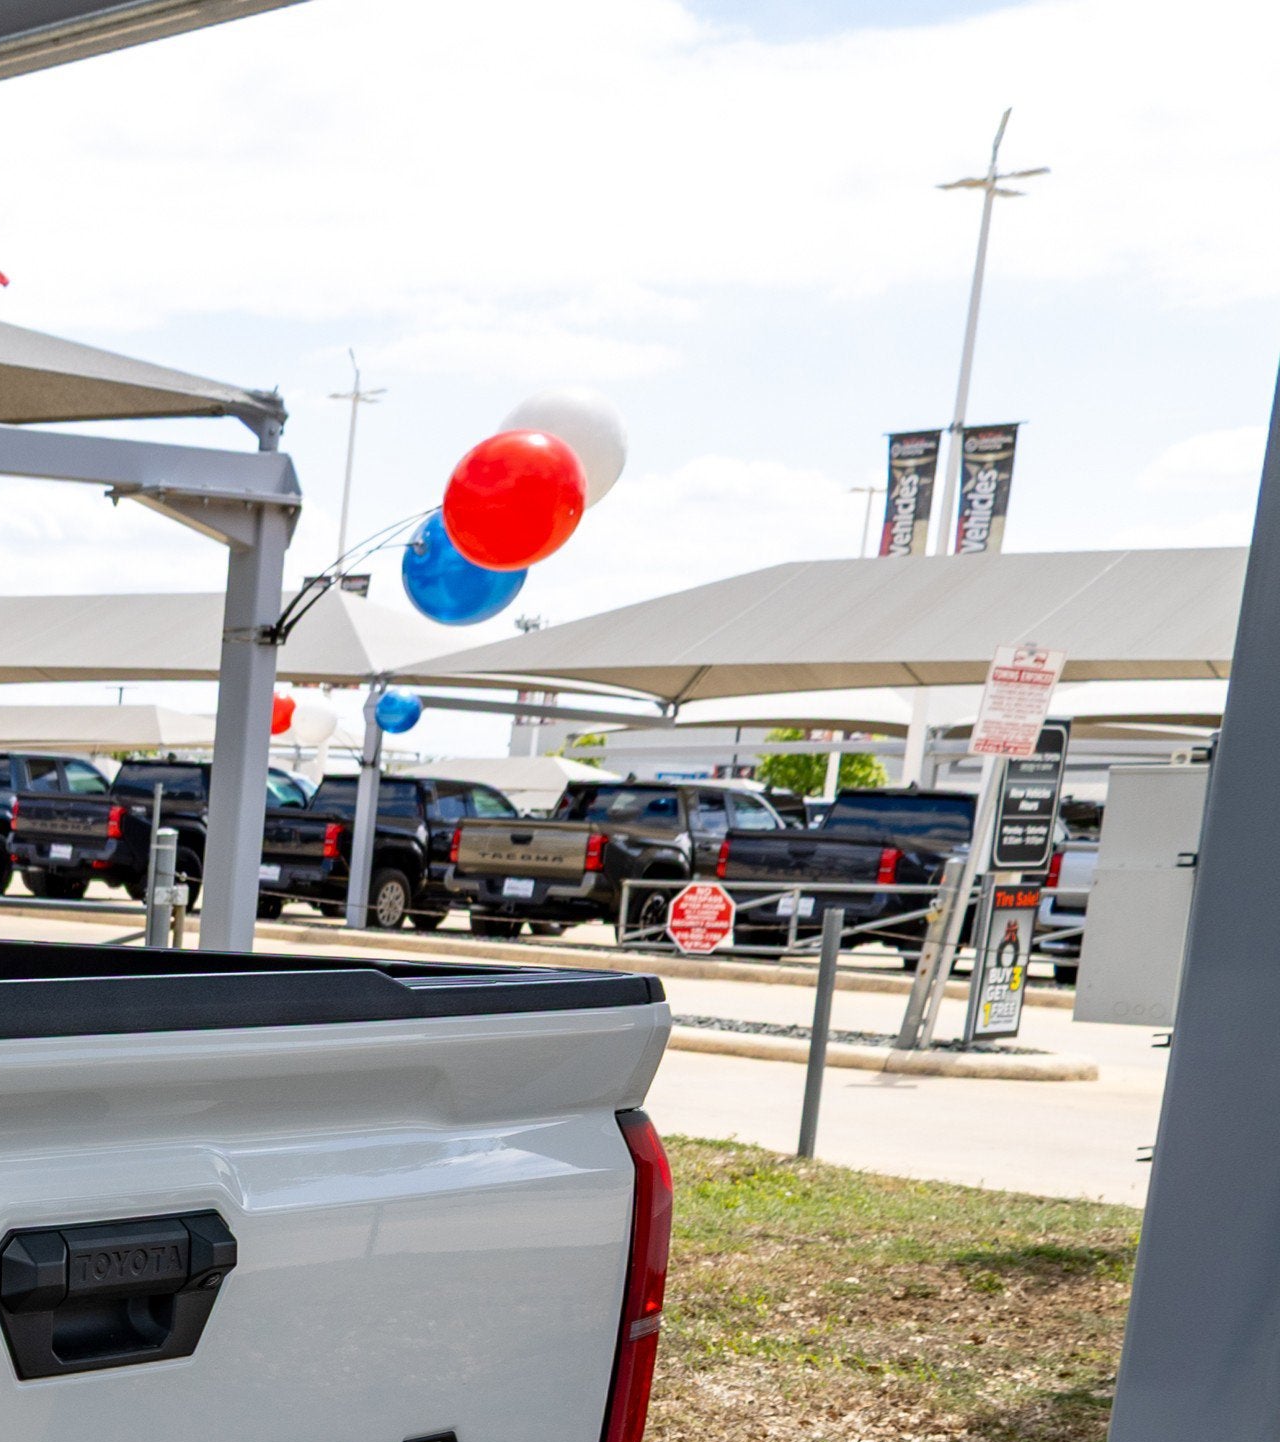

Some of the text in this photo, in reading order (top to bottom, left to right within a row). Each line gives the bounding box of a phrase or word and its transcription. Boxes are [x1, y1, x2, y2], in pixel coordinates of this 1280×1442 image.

[962, 468, 998, 554] Vehicles
[479, 851, 564, 863] TACOMA
[696, 887, 712, 896] NO
[996, 890, 1039, 907] Tire Sale!
[989, 965, 1023, 991] BUY 3
[987, 984, 1009, 1001] GET
[983, 1002, 992, 1027] 1
[991, 1003, 1017, 1018] FREE
[75, 1245, 183, 1283] TOYOTA
